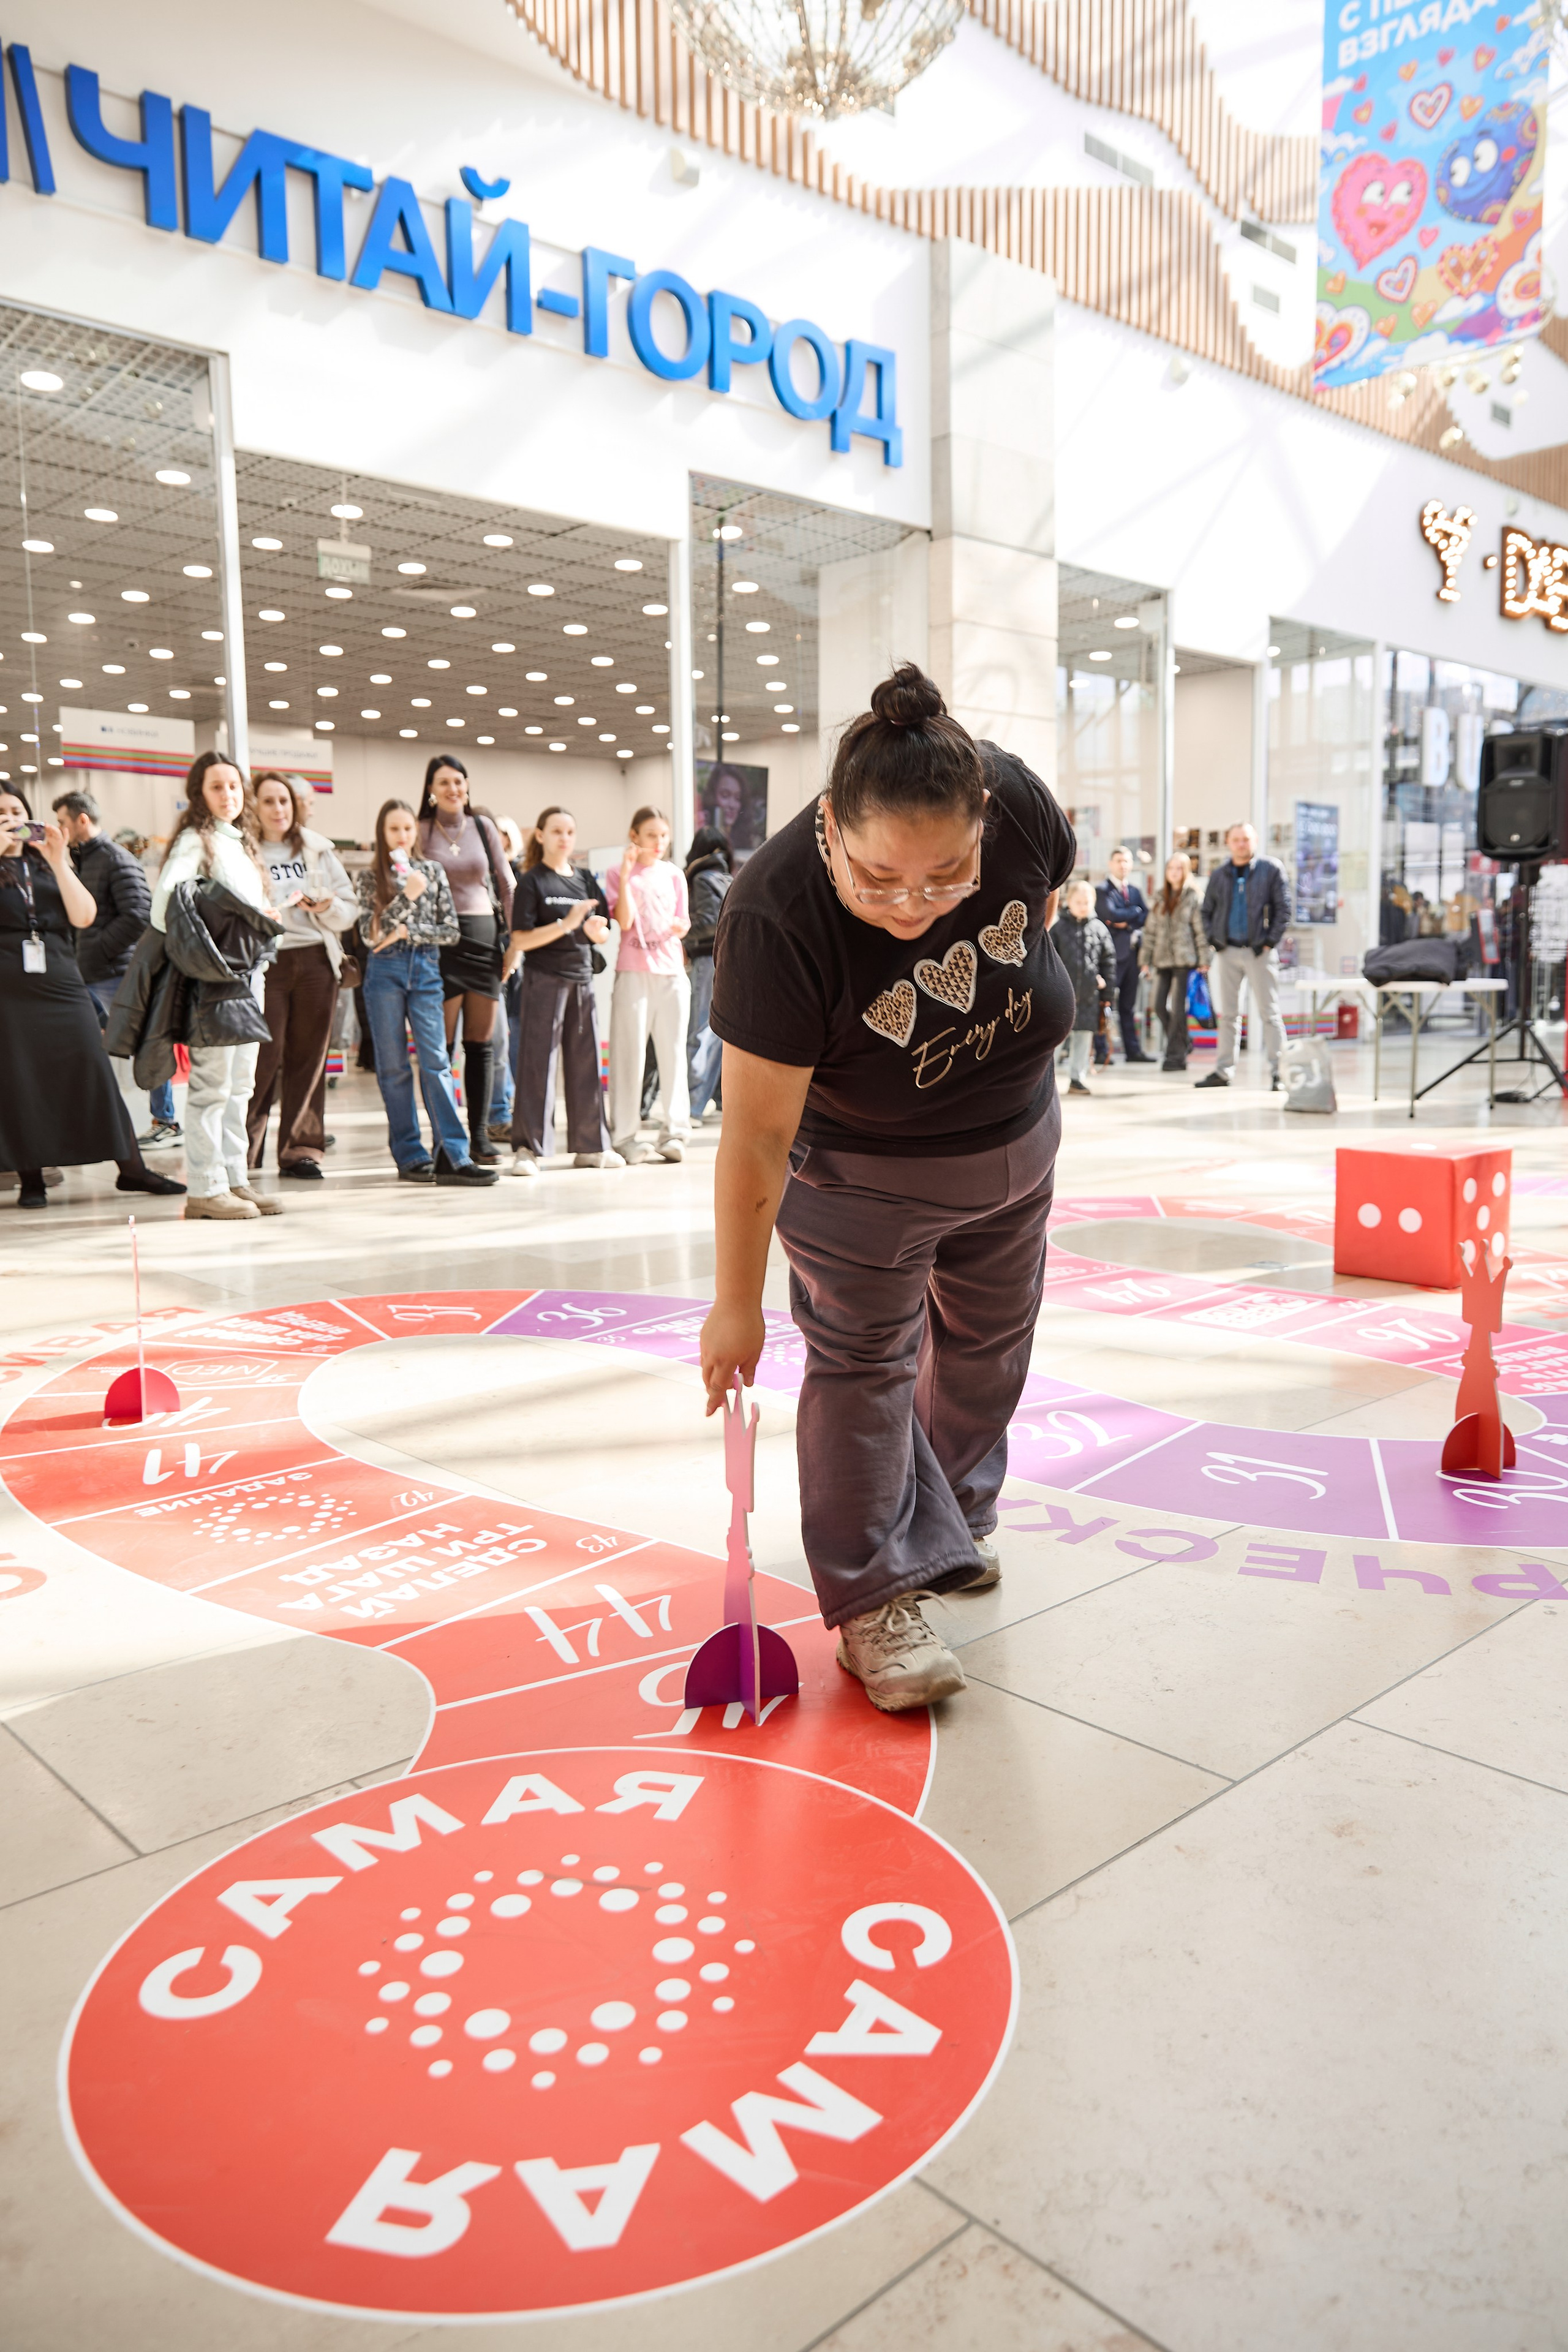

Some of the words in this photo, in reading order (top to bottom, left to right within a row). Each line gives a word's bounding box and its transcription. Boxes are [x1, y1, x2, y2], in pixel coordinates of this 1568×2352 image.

[64, 63, 903, 469] ЧИТАЙ-ГОРОД
[270, 861, 307, 880] STO
[1082, 1278, 1172, 1305] 24
[537, 1302, 627, 1329] 36
[631, 1314, 710, 1335] СДЕЛ
[1355, 1317, 1461, 1351] 26
[597, 1333, 626, 1344] 35
[172, 1364, 262, 1376] MED
[1008, 1410, 1133, 1459] 32
[143, 1442, 239, 1485] 41
[1200, 1451, 1329, 1501] 31
[134, 1471, 314, 1517] ЗАДАНИЕ
[398, 1489, 435, 1507] 42
[277, 1522, 464, 1586] НАЗАД
[428, 1522, 535, 1558] ТРИ
[575, 1533, 619, 1554] 43
[277, 1555, 439, 1611] ШАГА
[340, 1537, 548, 1619] СДЕЛАЙ
[524, 1583, 673, 1664] 44
[138, 1770, 706, 2021] САМАЯ
[323, 1901, 953, 2256] САМАЯ
